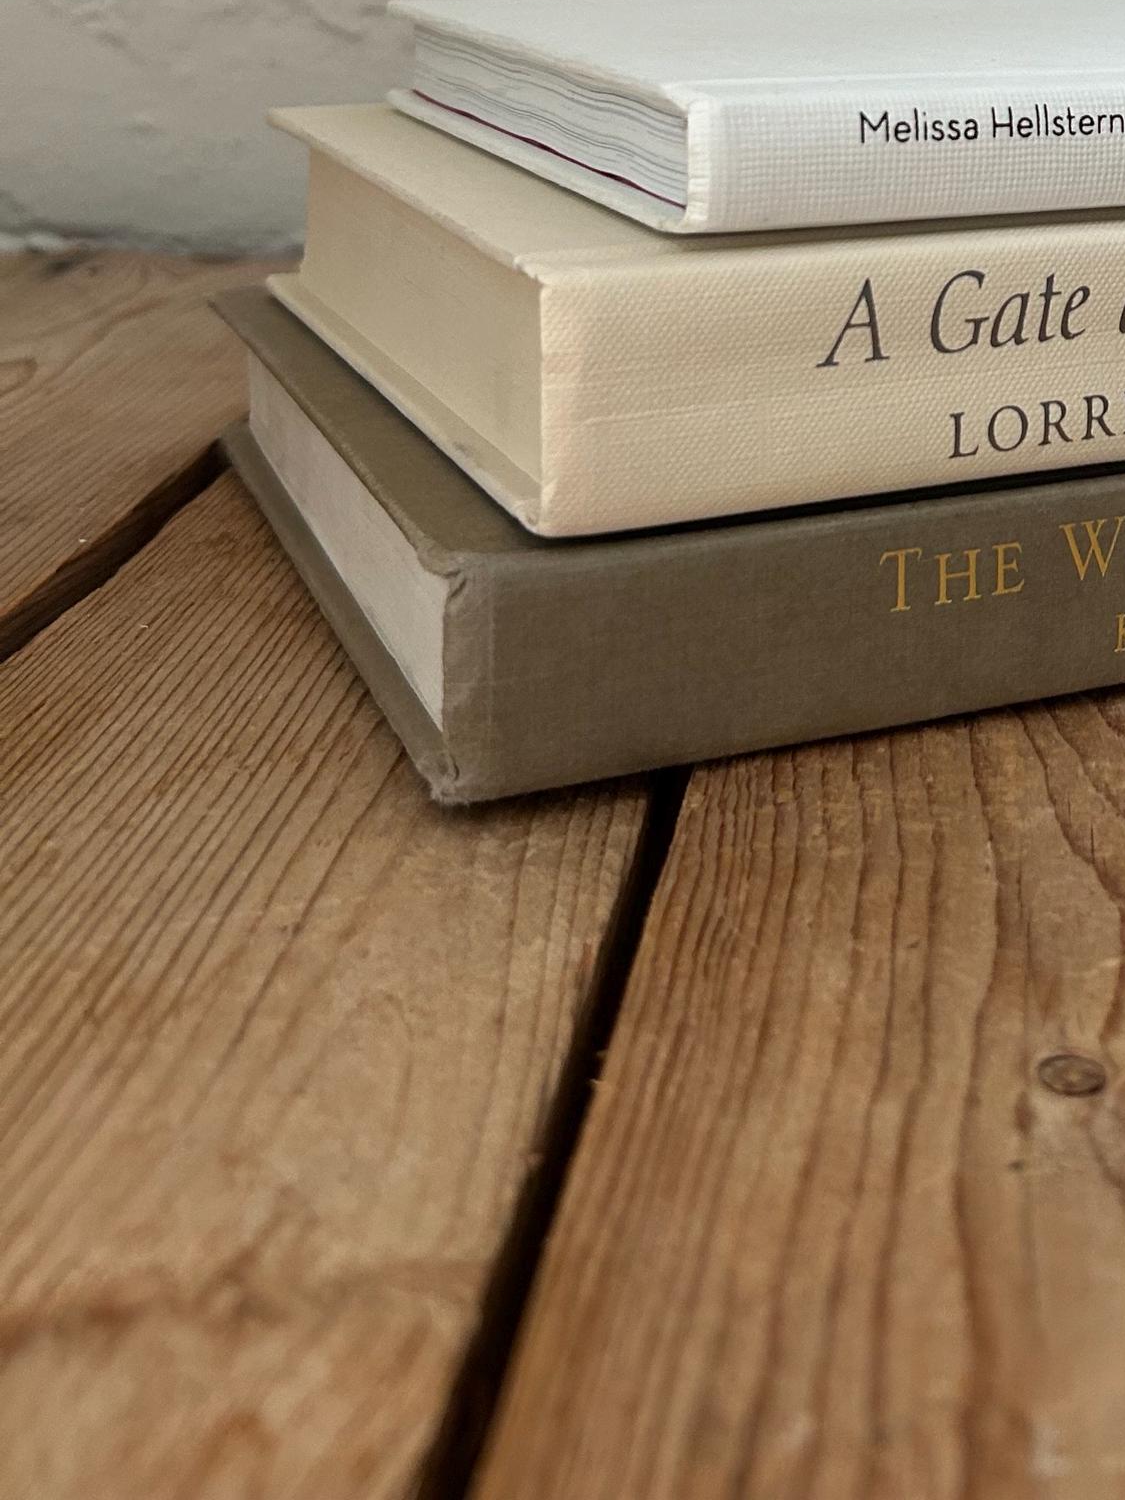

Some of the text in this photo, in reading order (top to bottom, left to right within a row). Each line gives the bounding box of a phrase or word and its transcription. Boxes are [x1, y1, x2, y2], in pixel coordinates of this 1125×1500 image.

[859, 103, 1125, 145] Melissa Hellstern
[816, 277, 891, 368] A
[929, 269, 1091, 355] Gate
[879, 542, 1025, 612] THE
